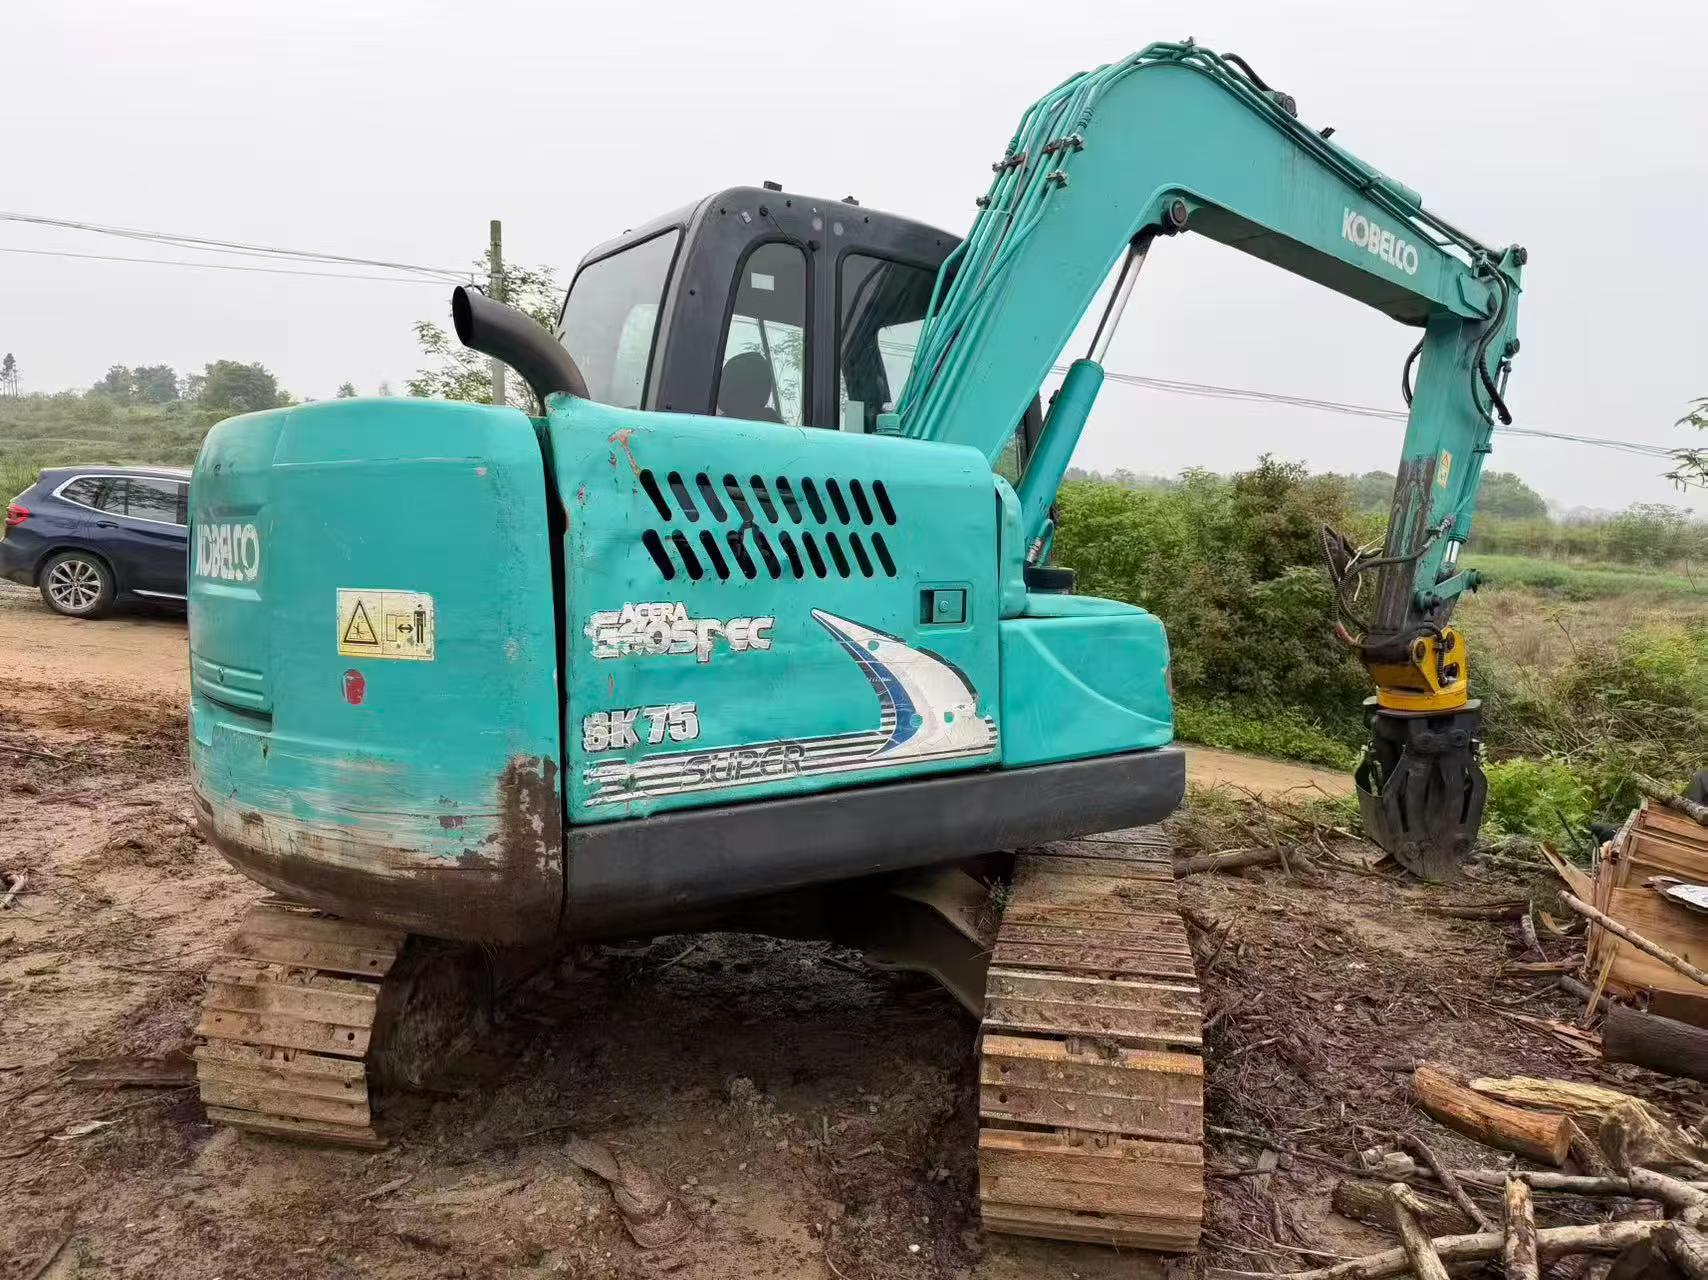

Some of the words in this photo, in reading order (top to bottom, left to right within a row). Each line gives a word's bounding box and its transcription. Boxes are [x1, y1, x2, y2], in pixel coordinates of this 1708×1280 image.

[1342, 207, 1418, 275] KOBELCO
[195, 523, 260, 581] KOBELCO
[681, 744, 806, 787] SUPER
